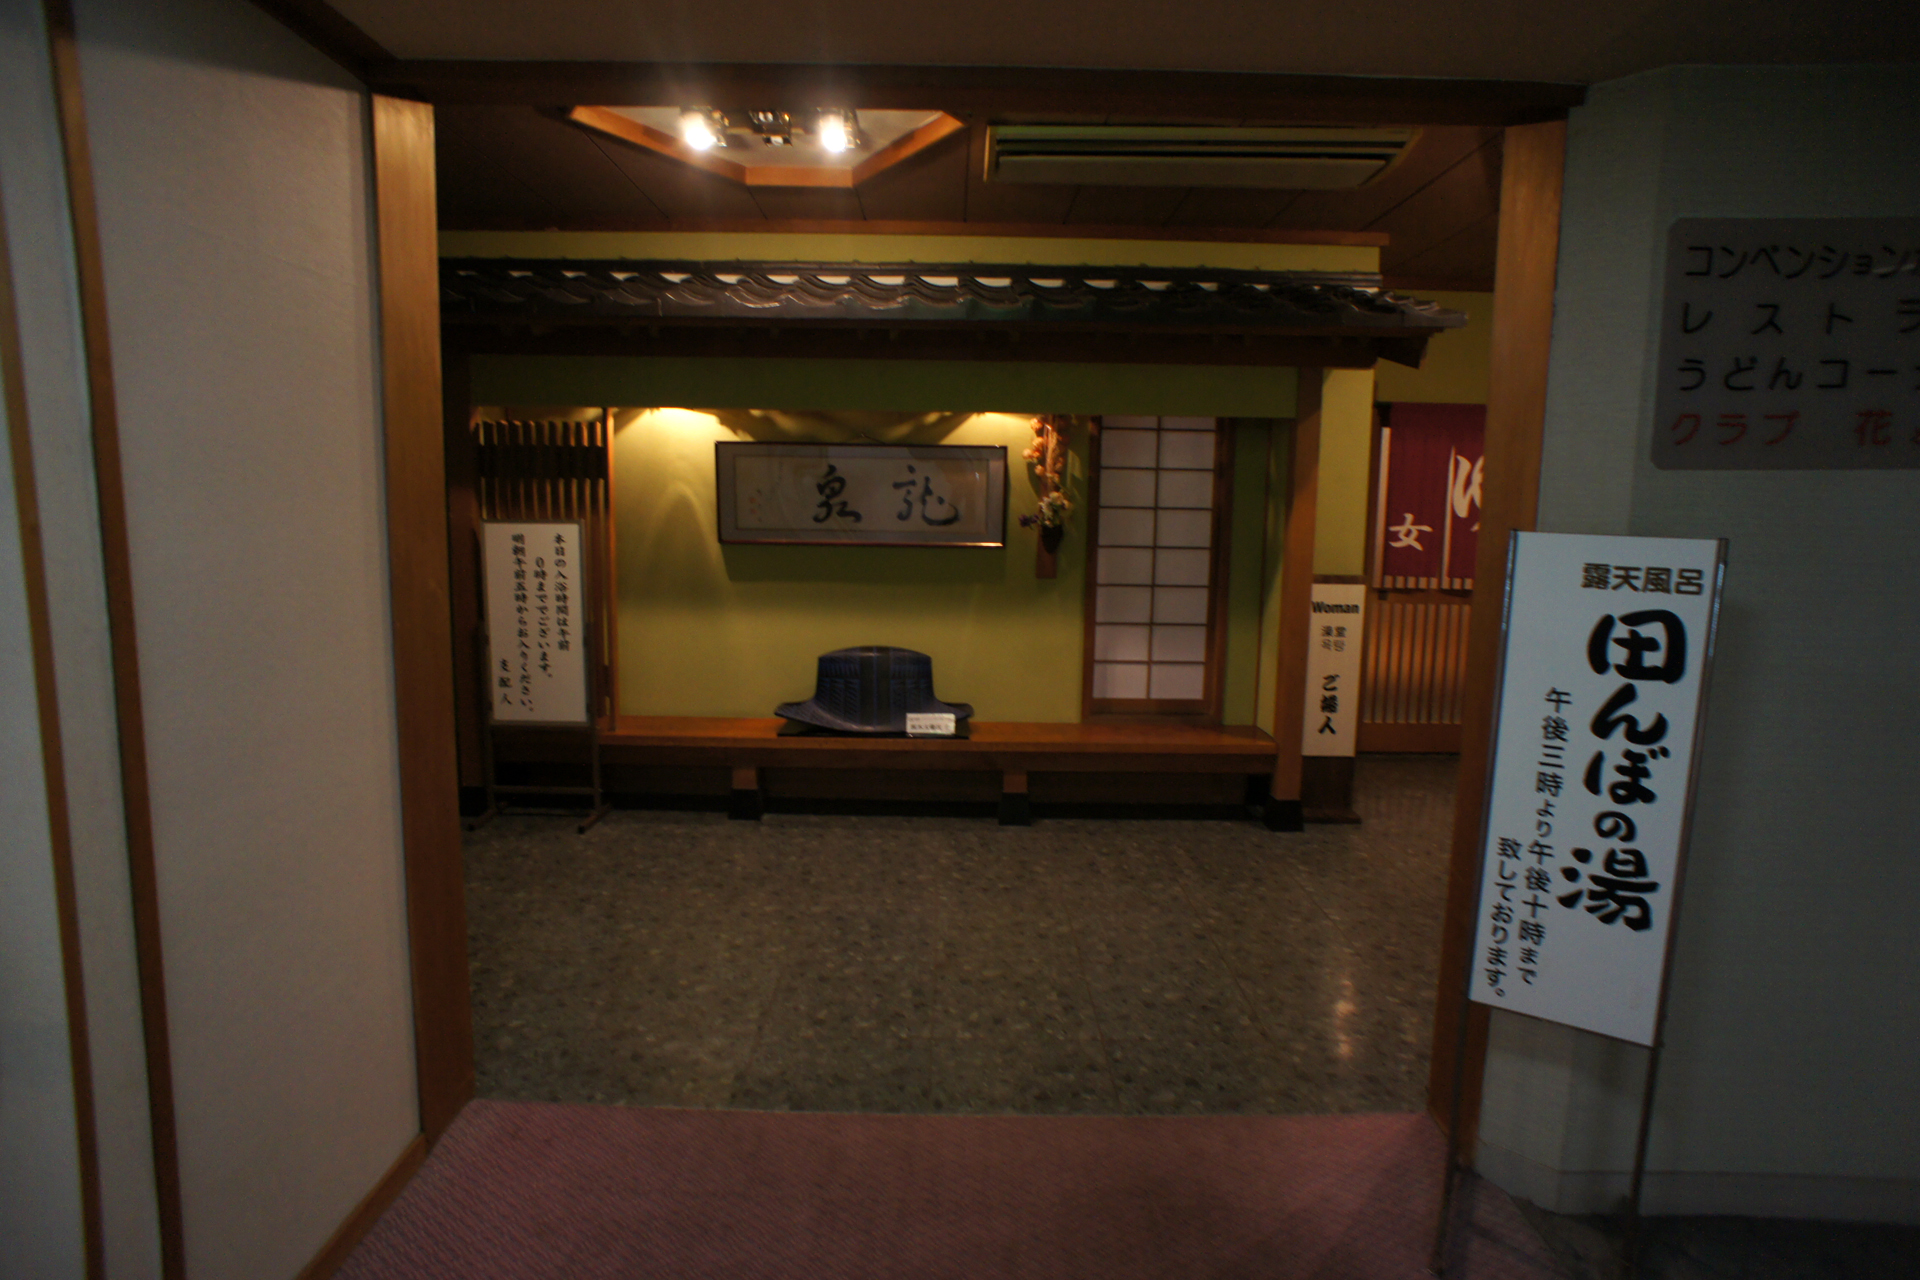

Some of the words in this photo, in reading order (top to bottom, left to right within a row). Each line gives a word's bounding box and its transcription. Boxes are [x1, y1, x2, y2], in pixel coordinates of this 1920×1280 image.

[1686, 245, 1919, 279] コンベンション
[1677, 356, 1919, 391] うどんコー
[1671, 409, 1801, 446] クラブ
[1853, 409, 1919, 447] 花
[1387, 512, 1434, 552] 女
[1581, 562, 1704, 596] 露天風呂
[1311, 600, 1360, 615] Woman
[1317, 673, 1341, 736] ご婦人
[1556, 608, 1687, 932] 田んぼの湯
[1484, 836, 1523, 998] 致しております。
